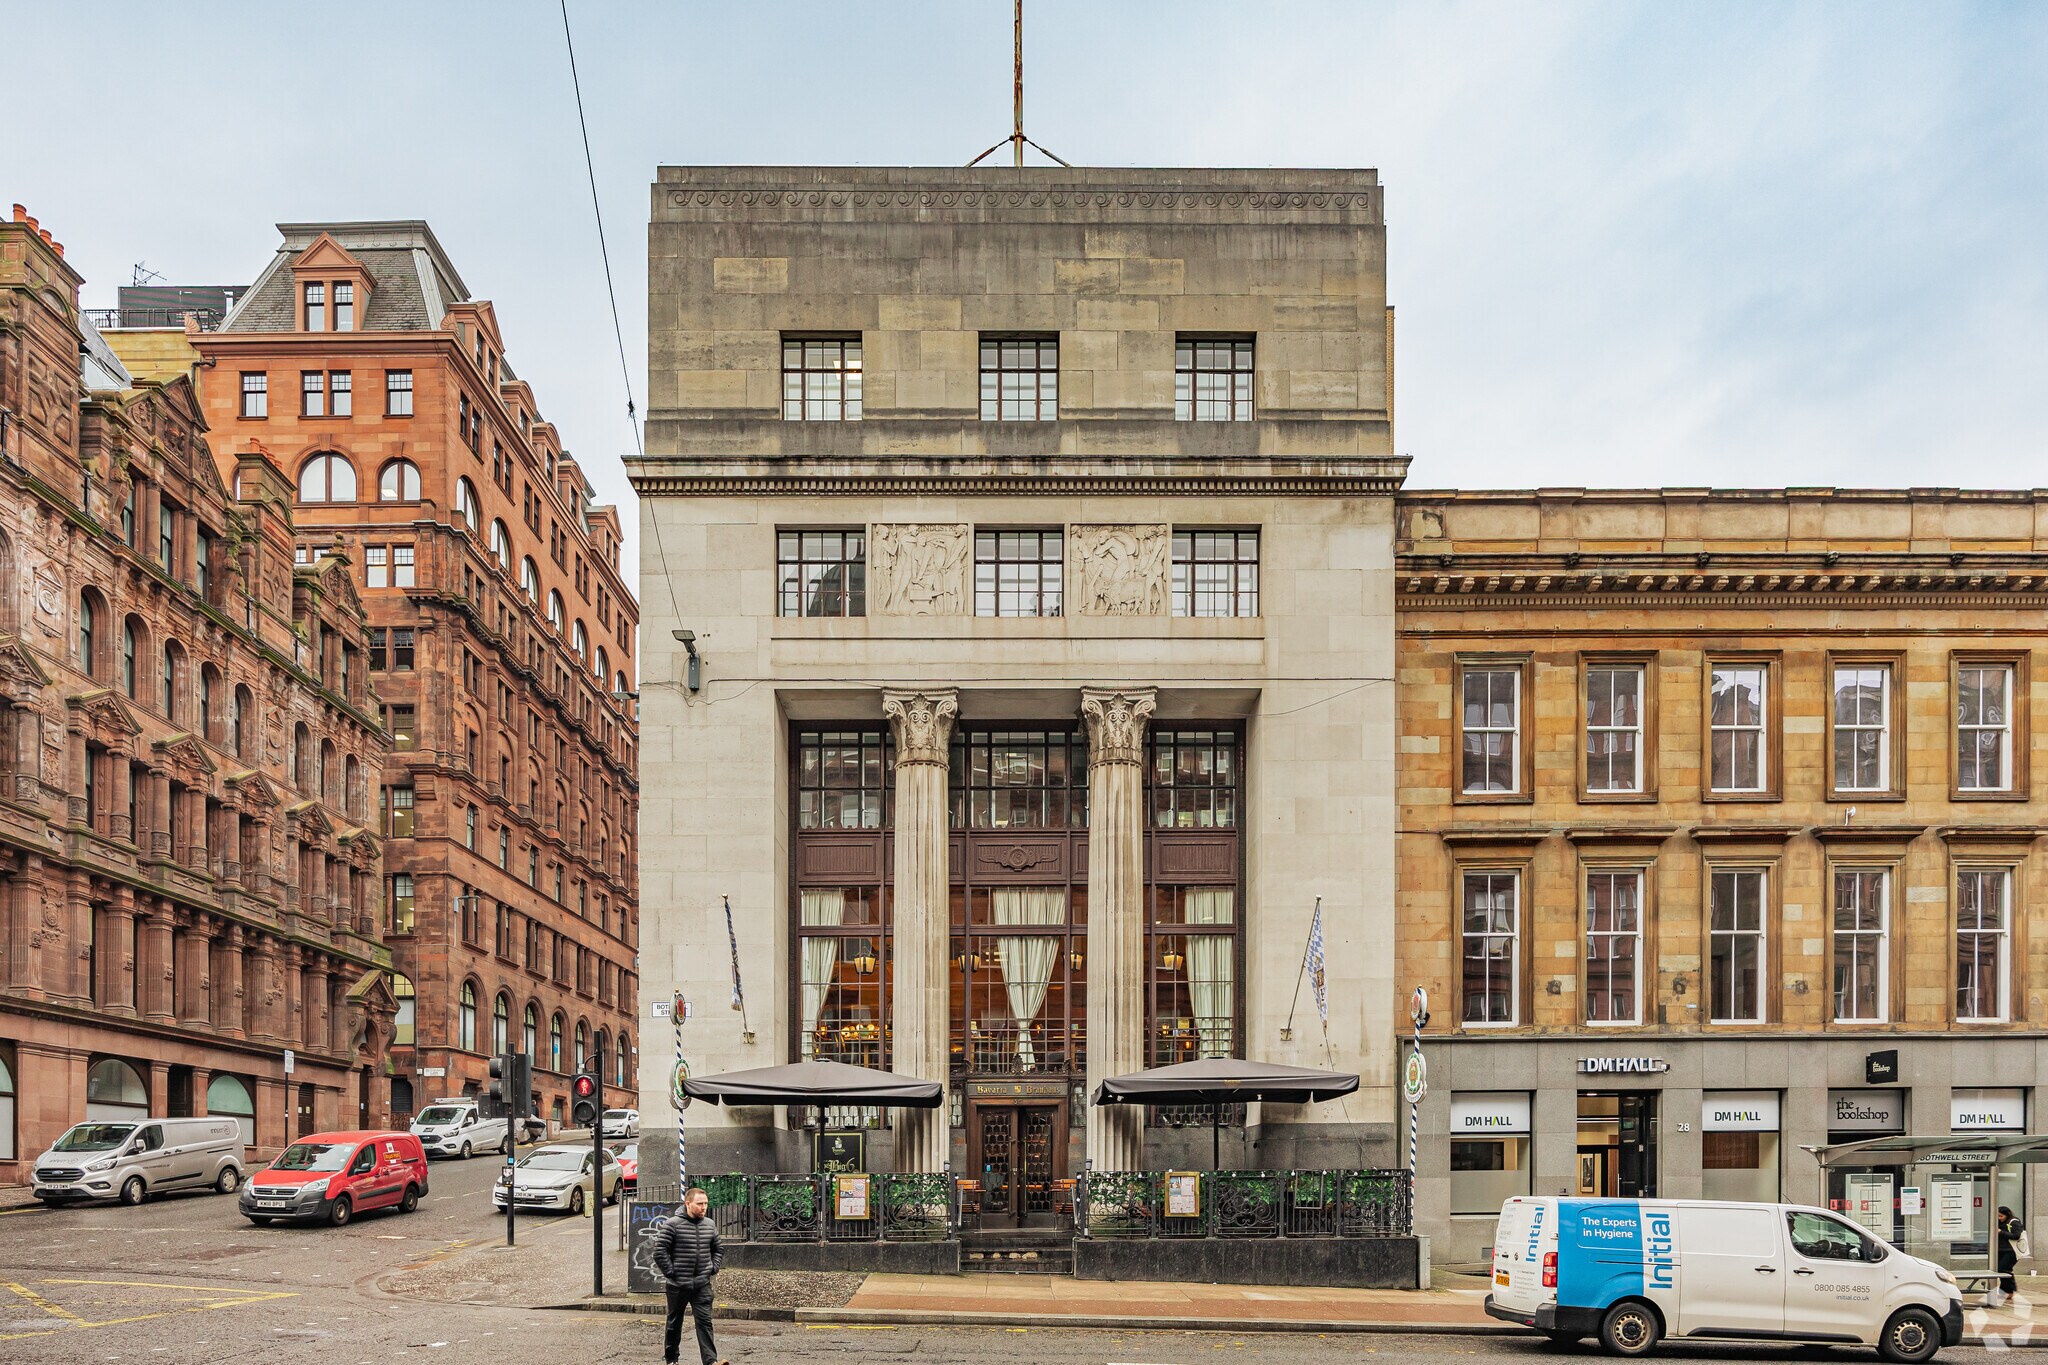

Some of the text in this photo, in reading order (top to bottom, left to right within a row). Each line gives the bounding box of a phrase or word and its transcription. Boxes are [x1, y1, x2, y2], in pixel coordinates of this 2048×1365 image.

[1587, 1057, 1657, 1072] DM HALL
[977, 1085, 1061, 1094] Bavaria Brauhaus
[1836, 1097, 1854, 1110] the
[1714, 1111, 1761, 1121] DM HALL
[1837, 1107, 1889, 1123] bookshop
[1959, 1114, 2005, 1124] DM HALL
[1465, 1116, 1512, 1126] DM HALL
[1677, 1123, 1690, 1132] 28
[1581, 1216, 1637, 1228] The Experts
[1583, 1228, 1633, 1239] in Hygiene
[1646, 1213, 1673, 1289] Initial
[1814, 1284, 1871, 1293] 0800 085 4855
